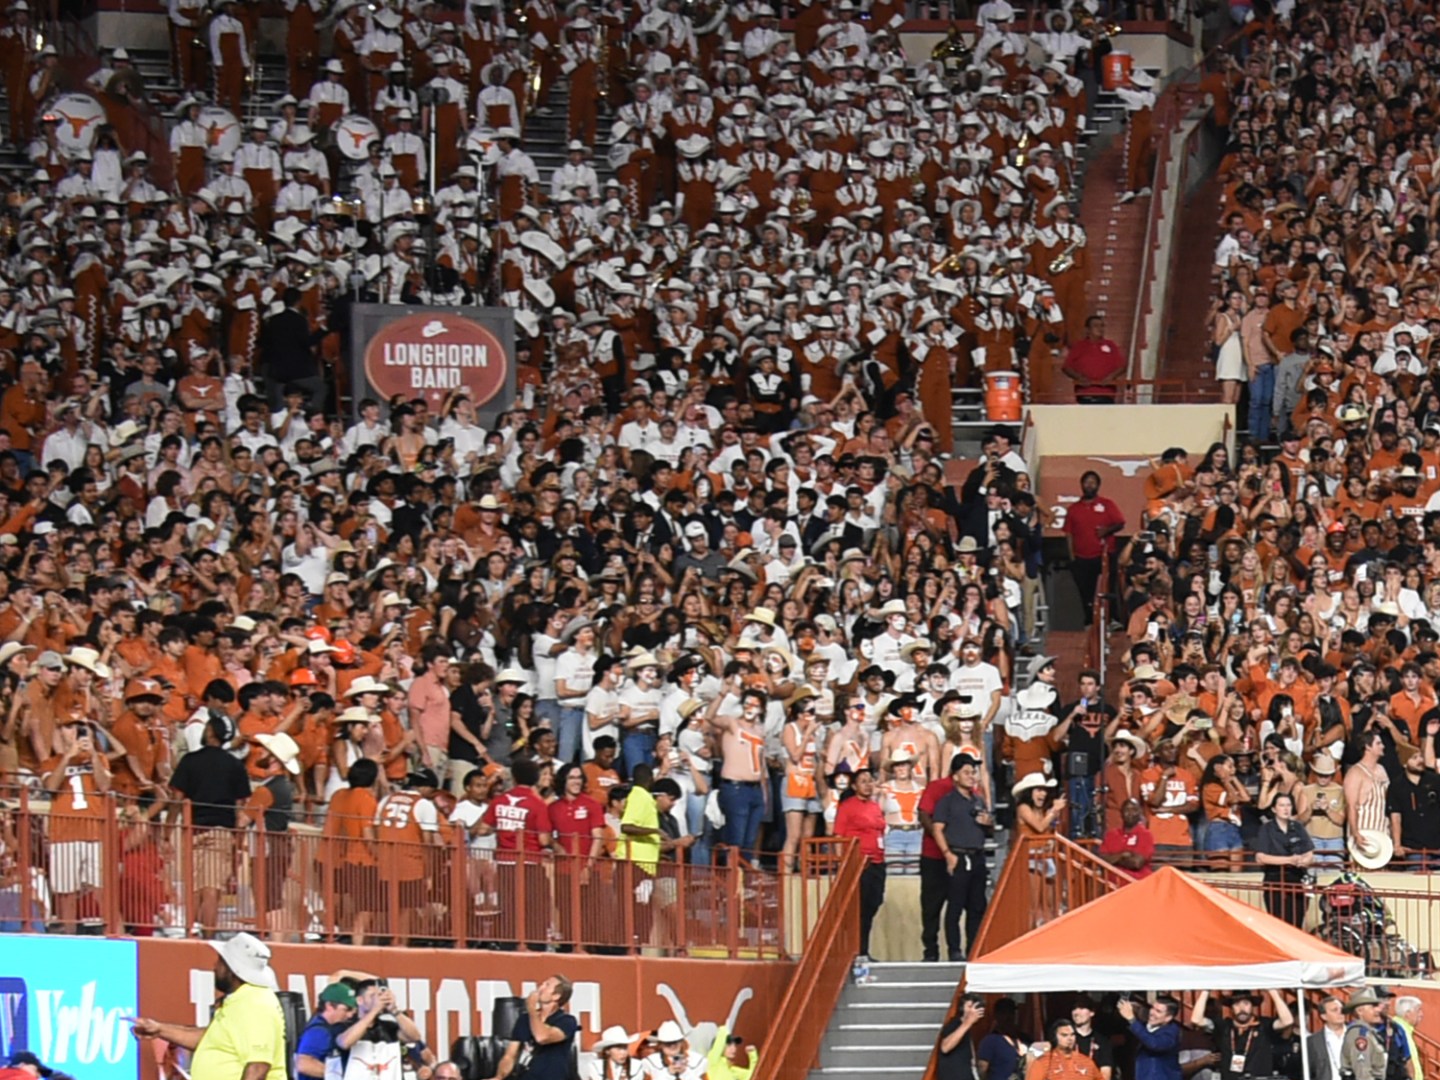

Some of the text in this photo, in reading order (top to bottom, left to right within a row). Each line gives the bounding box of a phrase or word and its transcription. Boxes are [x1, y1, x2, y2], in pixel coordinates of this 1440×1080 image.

[384, 343, 487, 367] LONGHORN
[411, 367, 462, 389] BAND
[1014, 712, 1047, 720] TEXAS
[69, 775, 88, 810] 1
[496, 804, 529, 820] EVENT
[35, 980, 132, 1064] Vrbo
